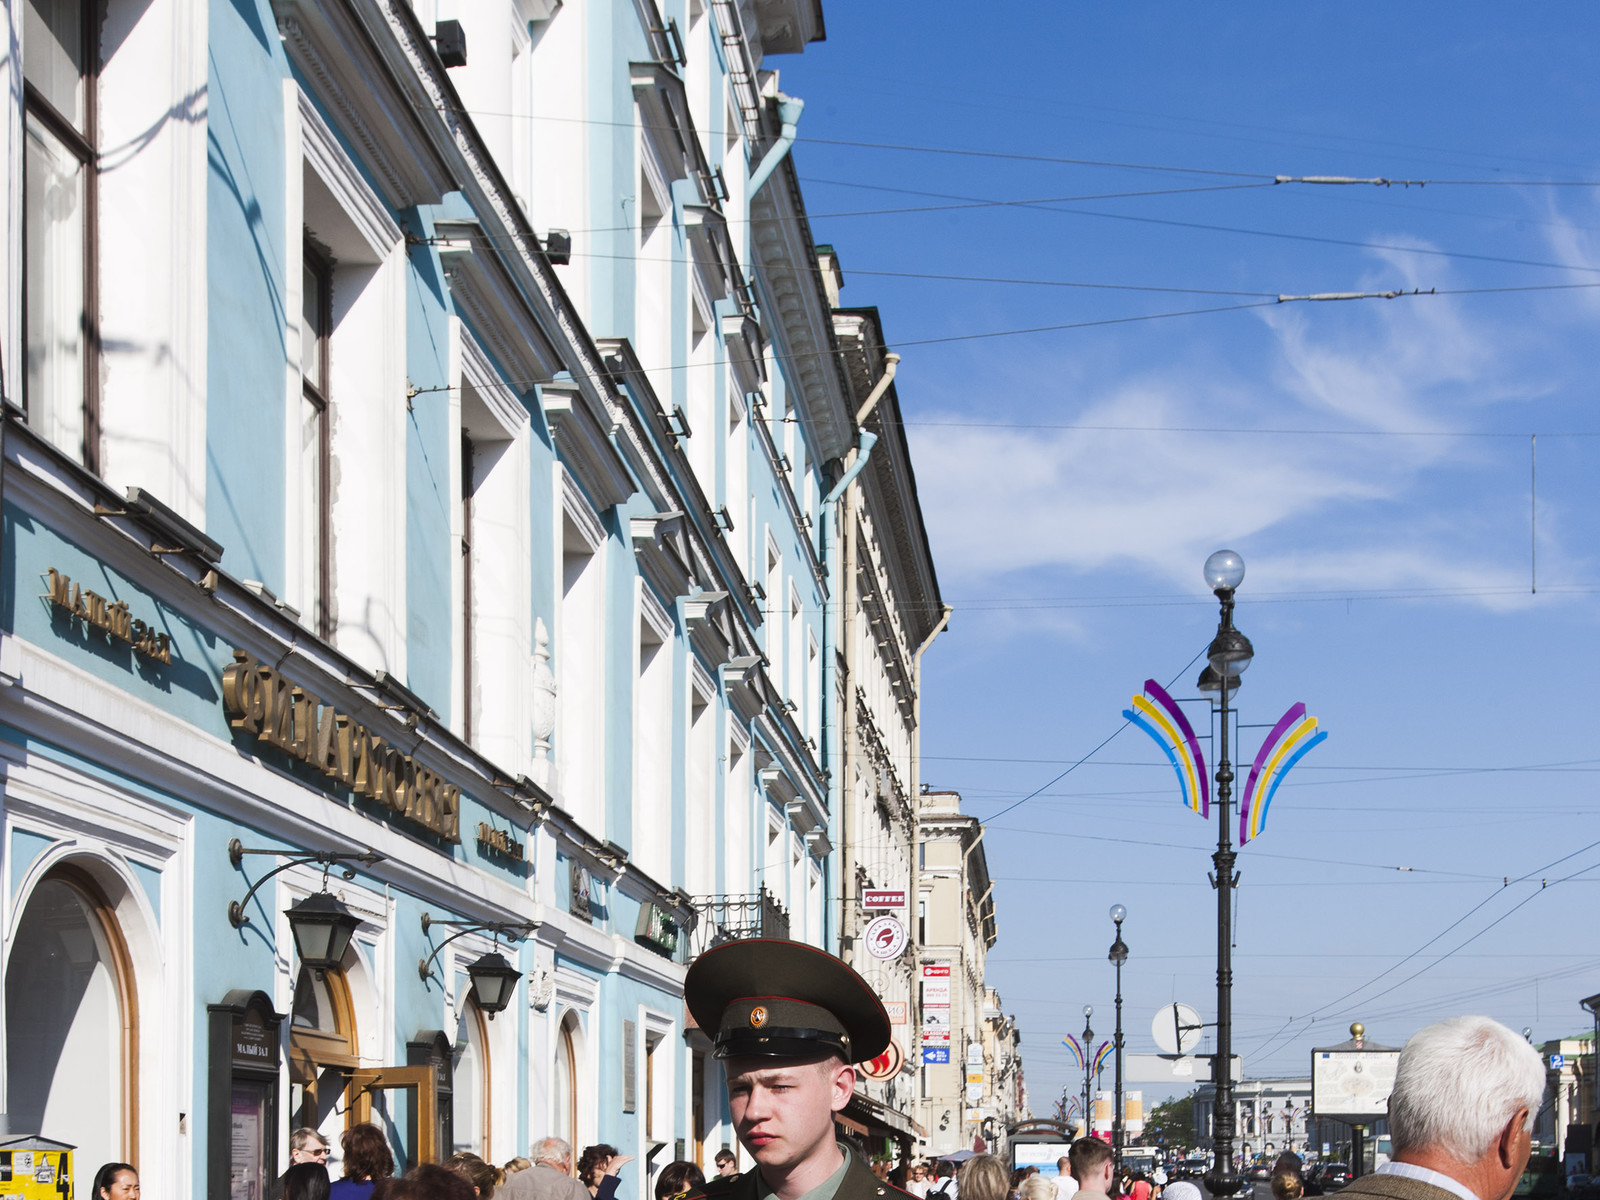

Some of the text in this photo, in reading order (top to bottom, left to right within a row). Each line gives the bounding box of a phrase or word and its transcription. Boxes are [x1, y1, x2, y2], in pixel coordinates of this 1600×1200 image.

[47, 567, 172, 665] МАЛЫЙ ЗАЛ
[222, 649, 462, 845] ФИЛАРМОНИЯ
[865, 895, 905, 903] COFFEE
[237, 1042, 258, 1056] МАЛЫЙ
